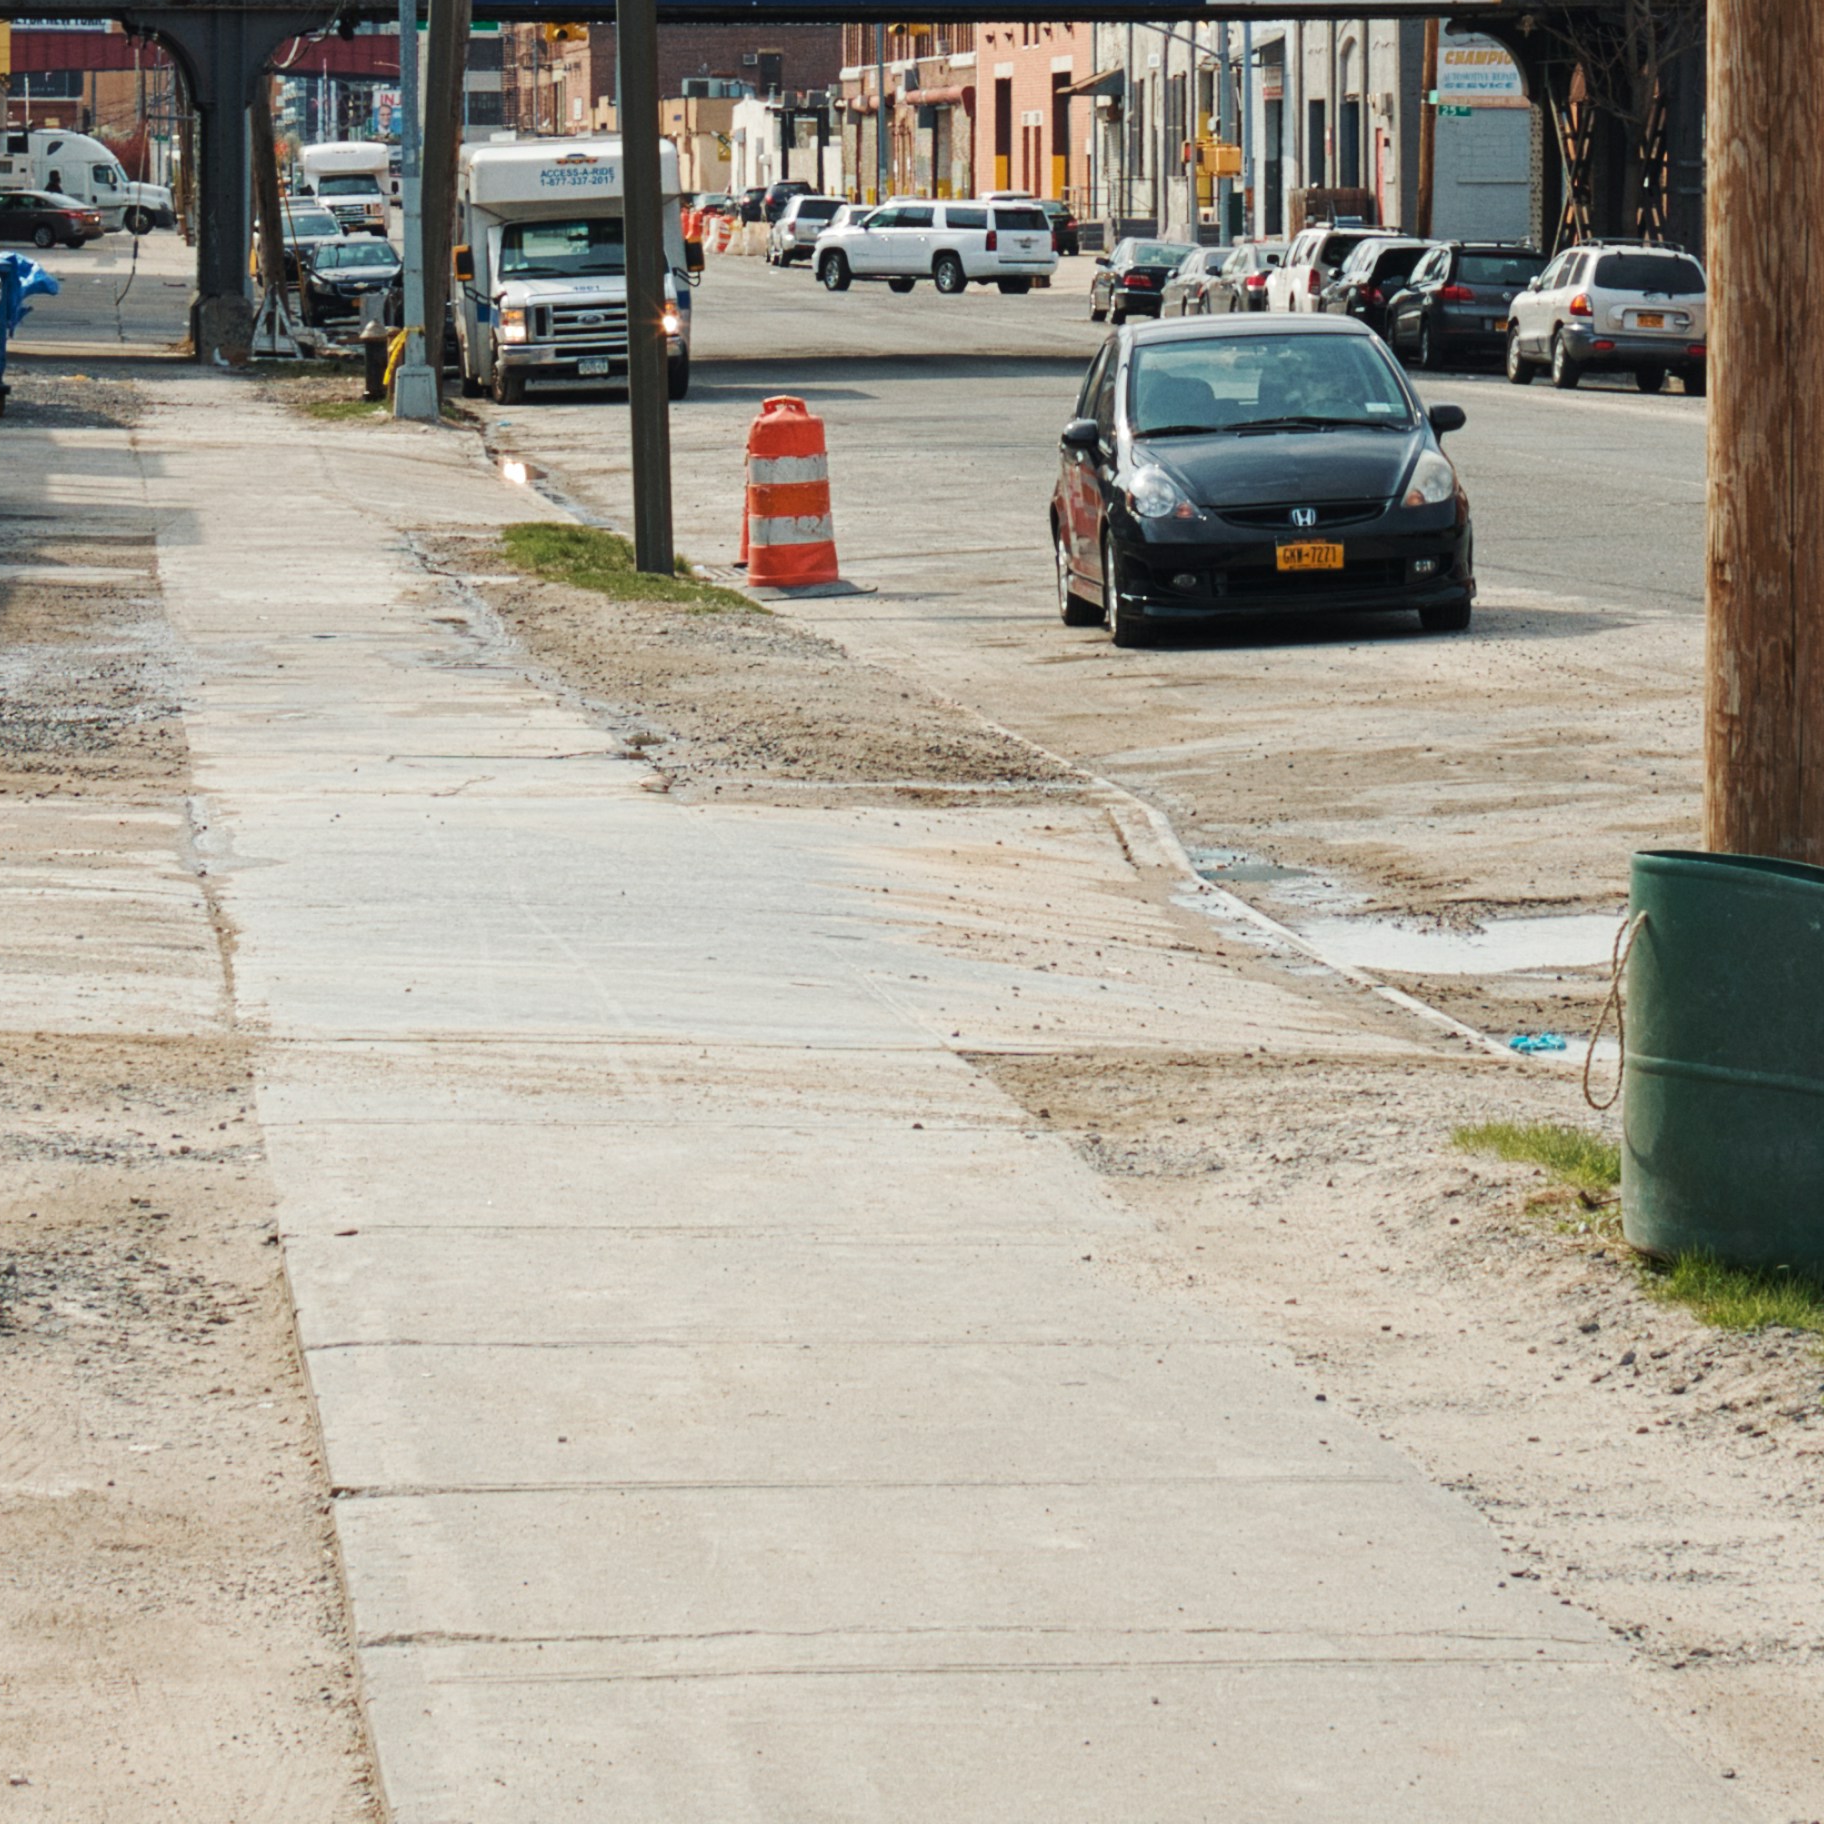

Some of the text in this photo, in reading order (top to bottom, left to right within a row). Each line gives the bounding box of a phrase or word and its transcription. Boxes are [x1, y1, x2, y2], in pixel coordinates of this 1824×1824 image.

[1444, 50, 1513, 65] CHAMPIO
[540, 167, 614, 177] ACCESS-A-RIDE
[540, 176, 614, 186] 1-877-337-2017
